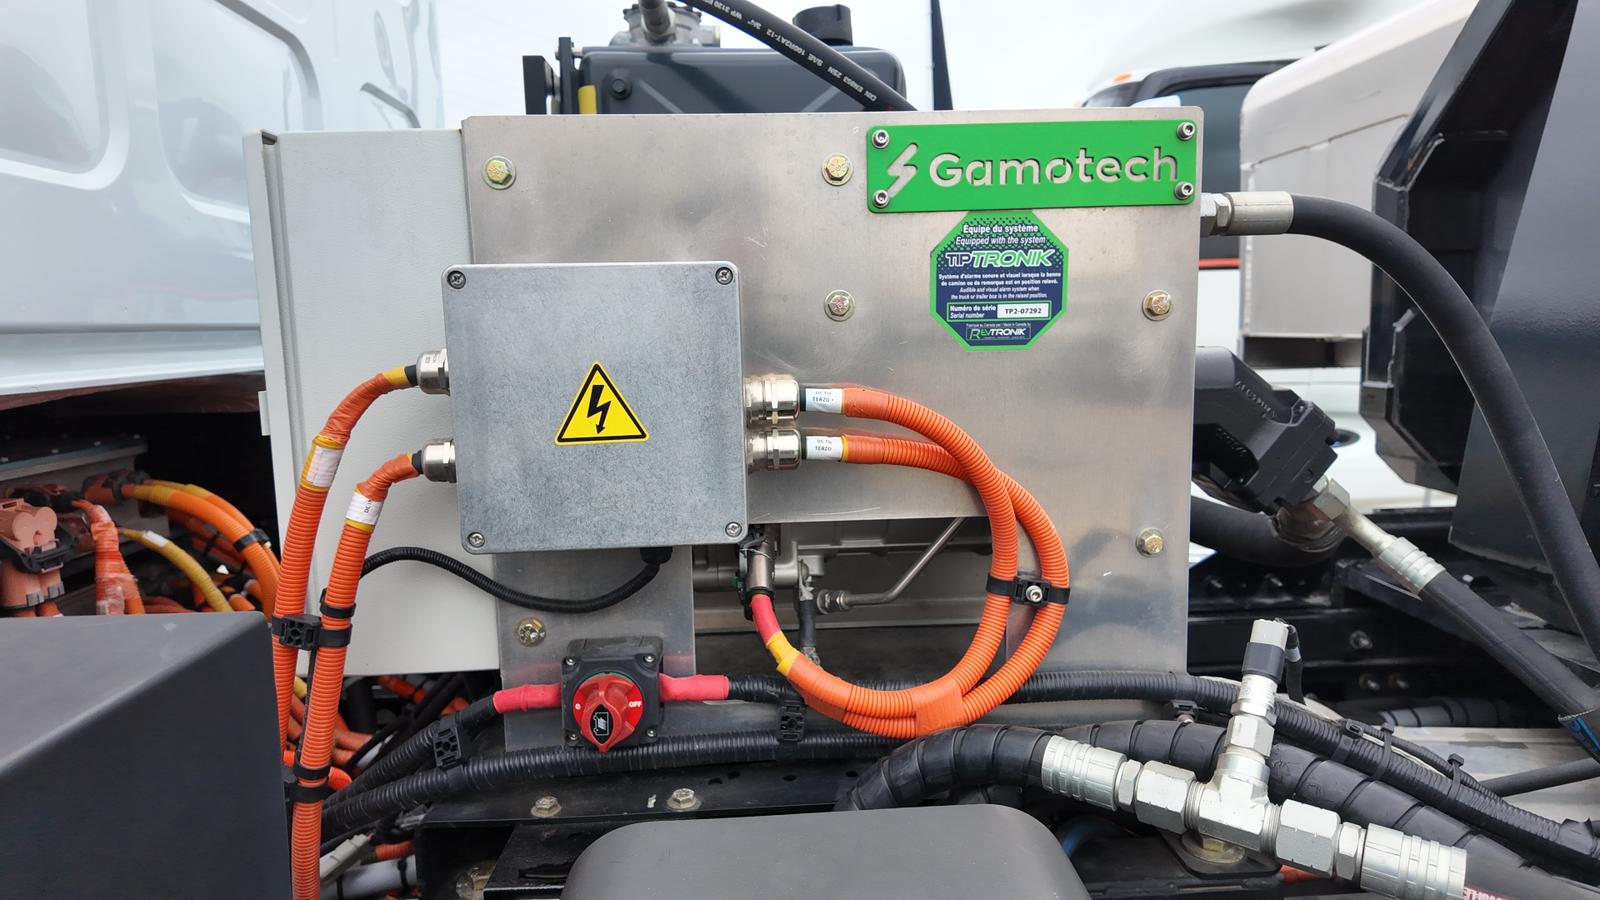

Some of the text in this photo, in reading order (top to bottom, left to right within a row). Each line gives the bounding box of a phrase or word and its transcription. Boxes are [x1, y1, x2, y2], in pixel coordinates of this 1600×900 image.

[929, 146, 1178, 187] Gamotech
[993, 224, 1003, 232] du
[1005, 224, 1039, 234] système
[956, 235, 1046, 246] Equipped with the system
